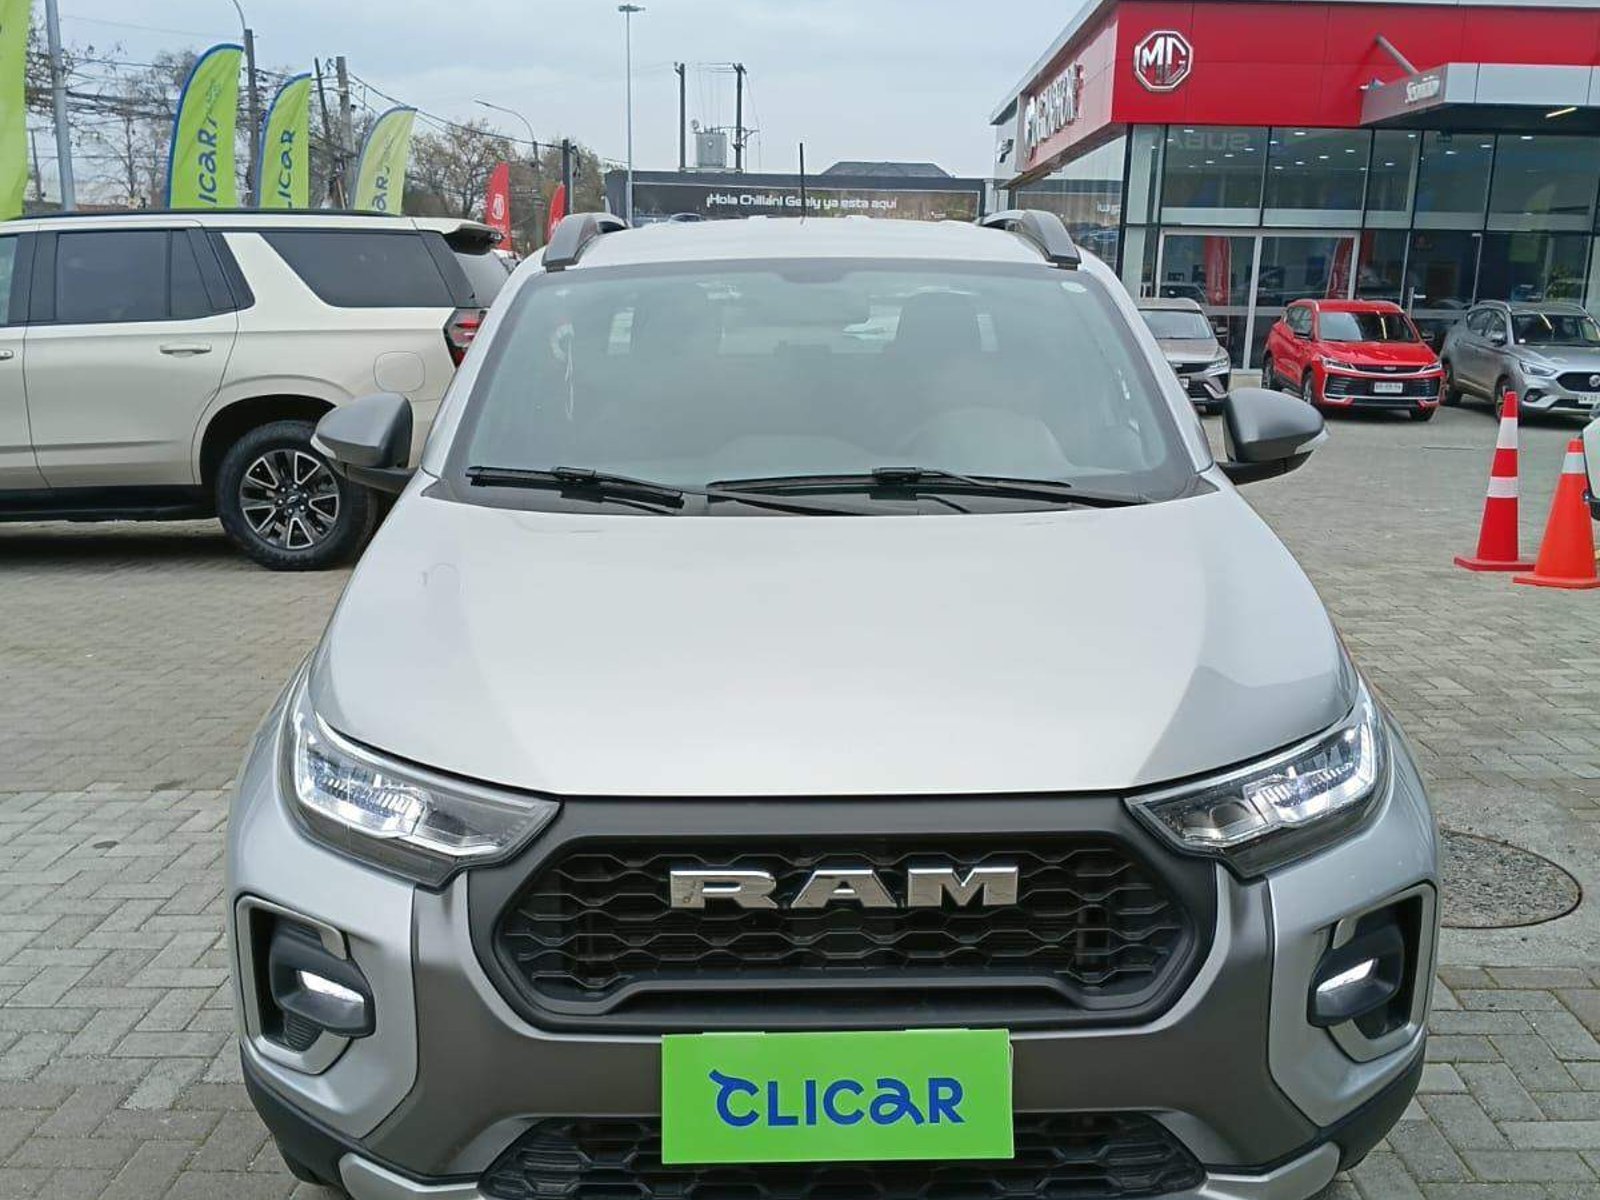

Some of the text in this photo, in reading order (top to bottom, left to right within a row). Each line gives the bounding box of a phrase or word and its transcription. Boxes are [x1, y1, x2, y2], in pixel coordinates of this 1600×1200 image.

[1141, 36, 1187, 83] MG
[823, 199, 839, 210] ya
[669, 865, 1020, 910] RAM
